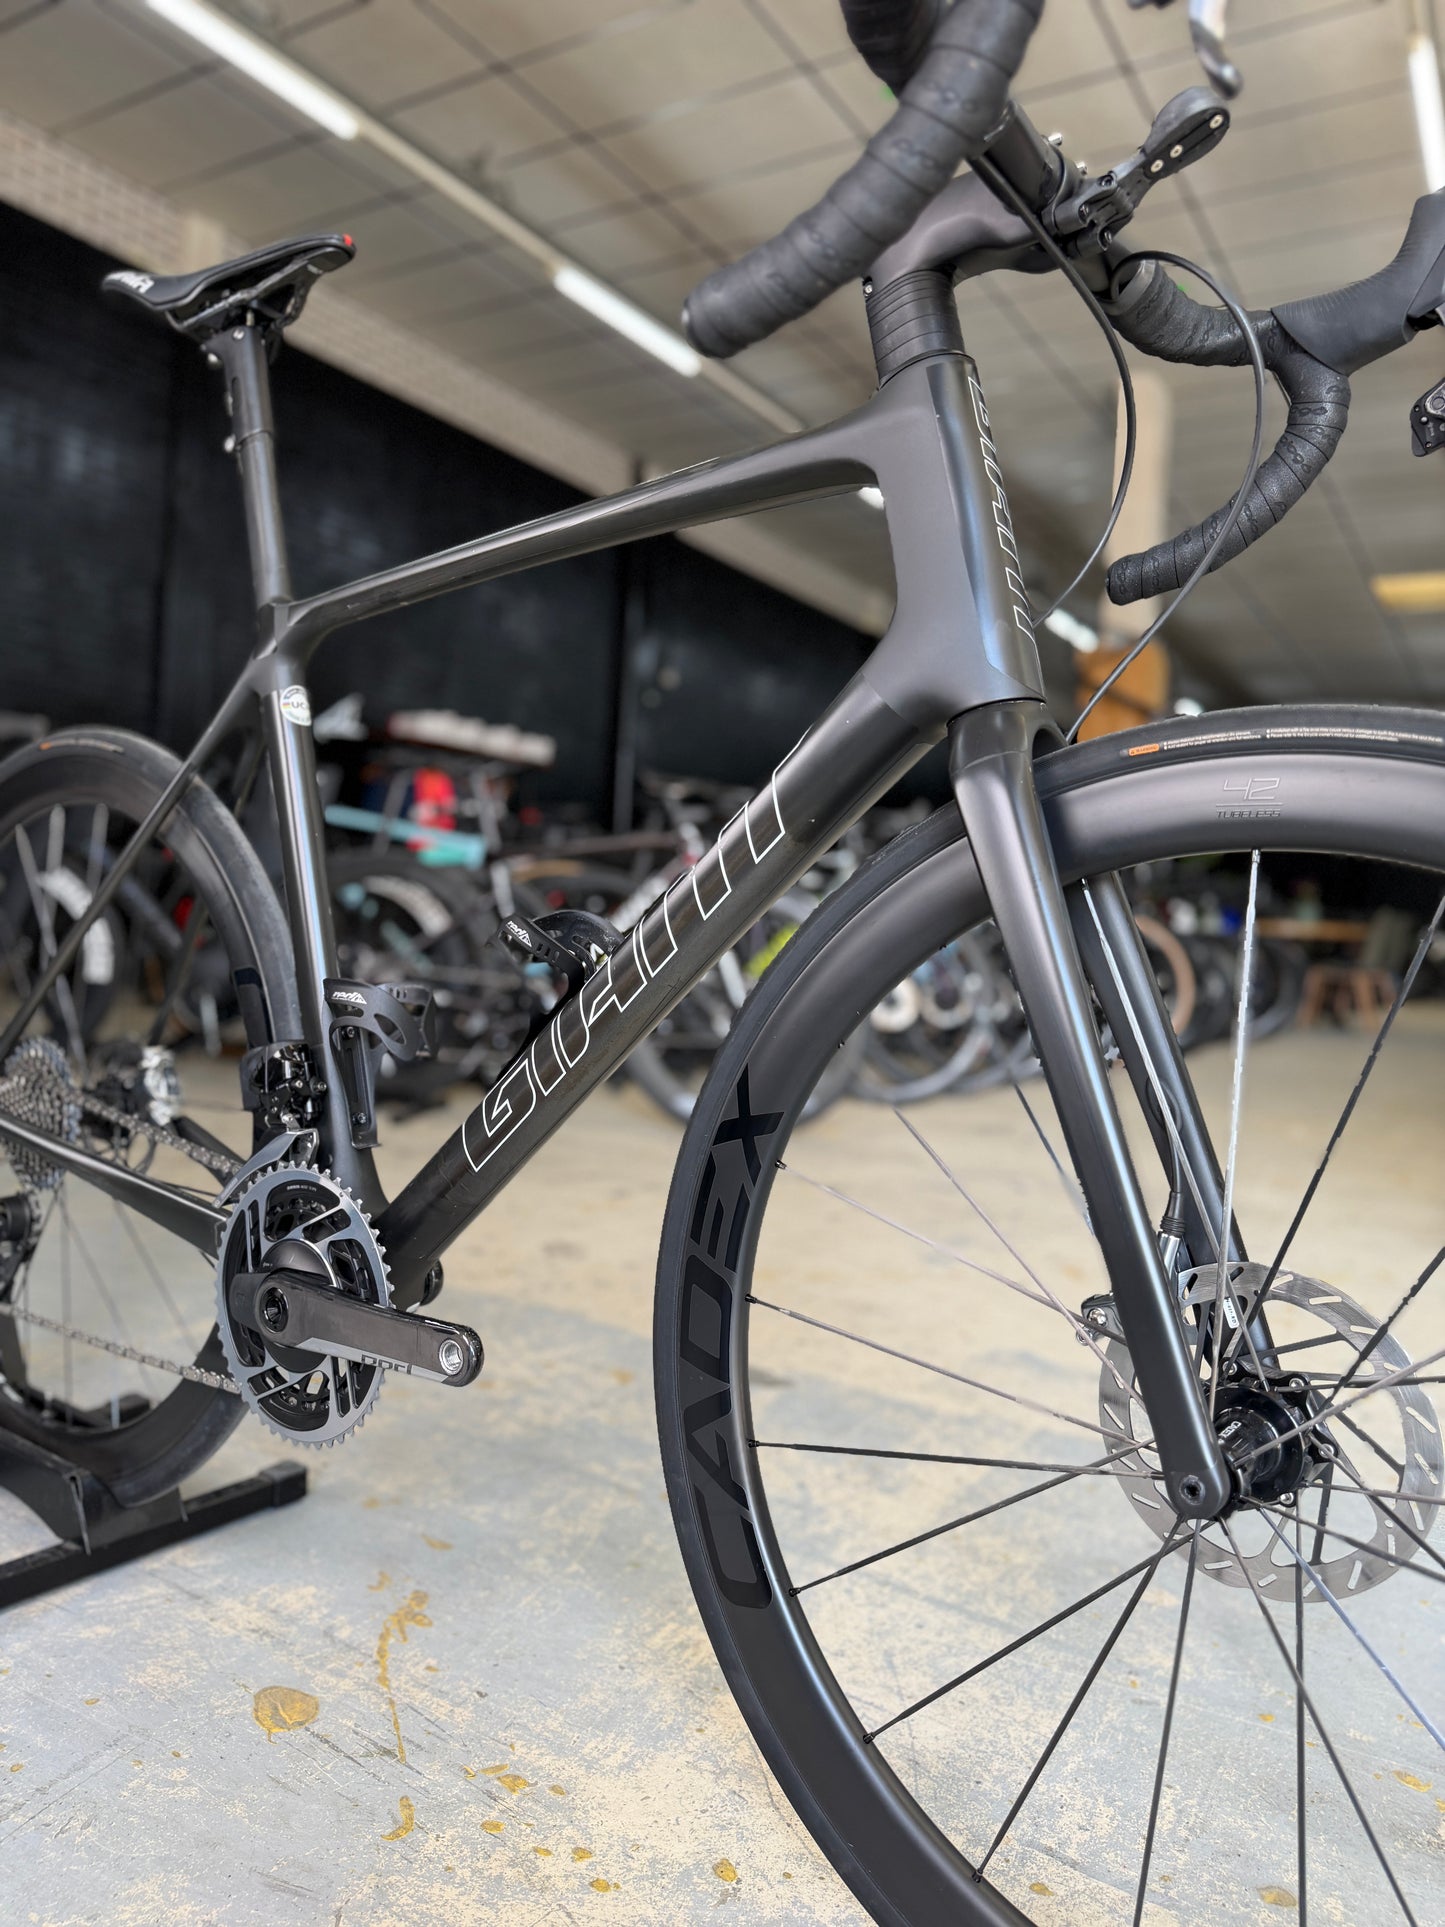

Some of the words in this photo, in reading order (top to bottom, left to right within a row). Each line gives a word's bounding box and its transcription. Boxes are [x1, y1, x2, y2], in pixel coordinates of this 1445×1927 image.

[1223, 777, 1280, 800] 42
[1216, 808, 1281, 818] TUBELESS
[680, 1063, 785, 1608] CADEX
